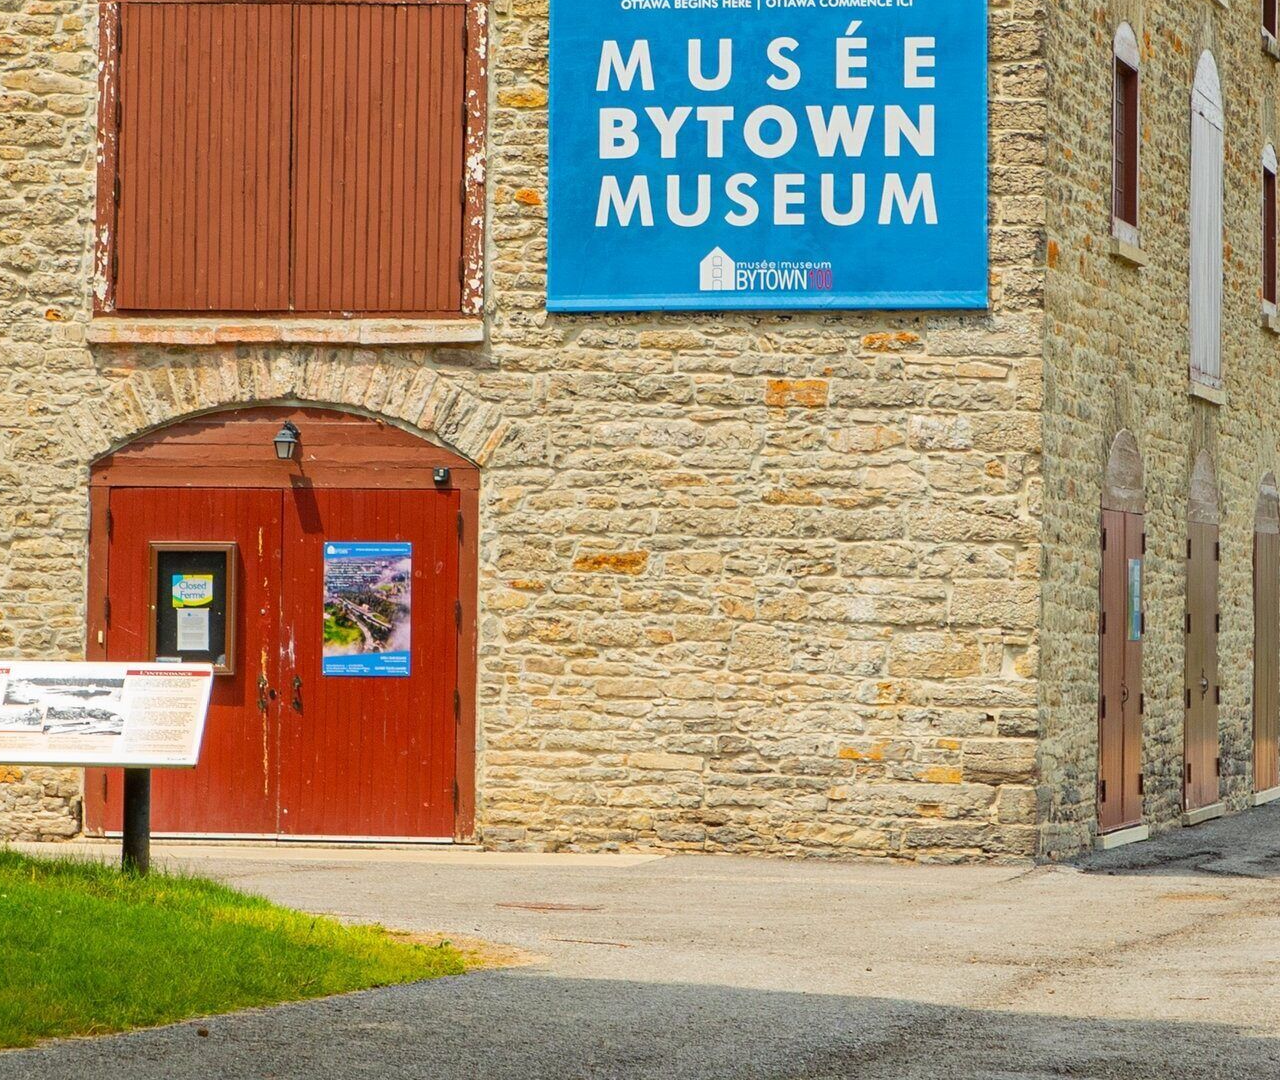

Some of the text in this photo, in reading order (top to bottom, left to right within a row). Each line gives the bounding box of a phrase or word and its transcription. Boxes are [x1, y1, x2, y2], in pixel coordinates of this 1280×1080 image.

[595, 20, 935, 92] MUSÉE
[599, 104, 935, 159] BYTOWN
[595, 172, 938, 227] MUSEUM
[179, 581, 206, 590] Closed
[180, 590, 205, 599] Fermé
